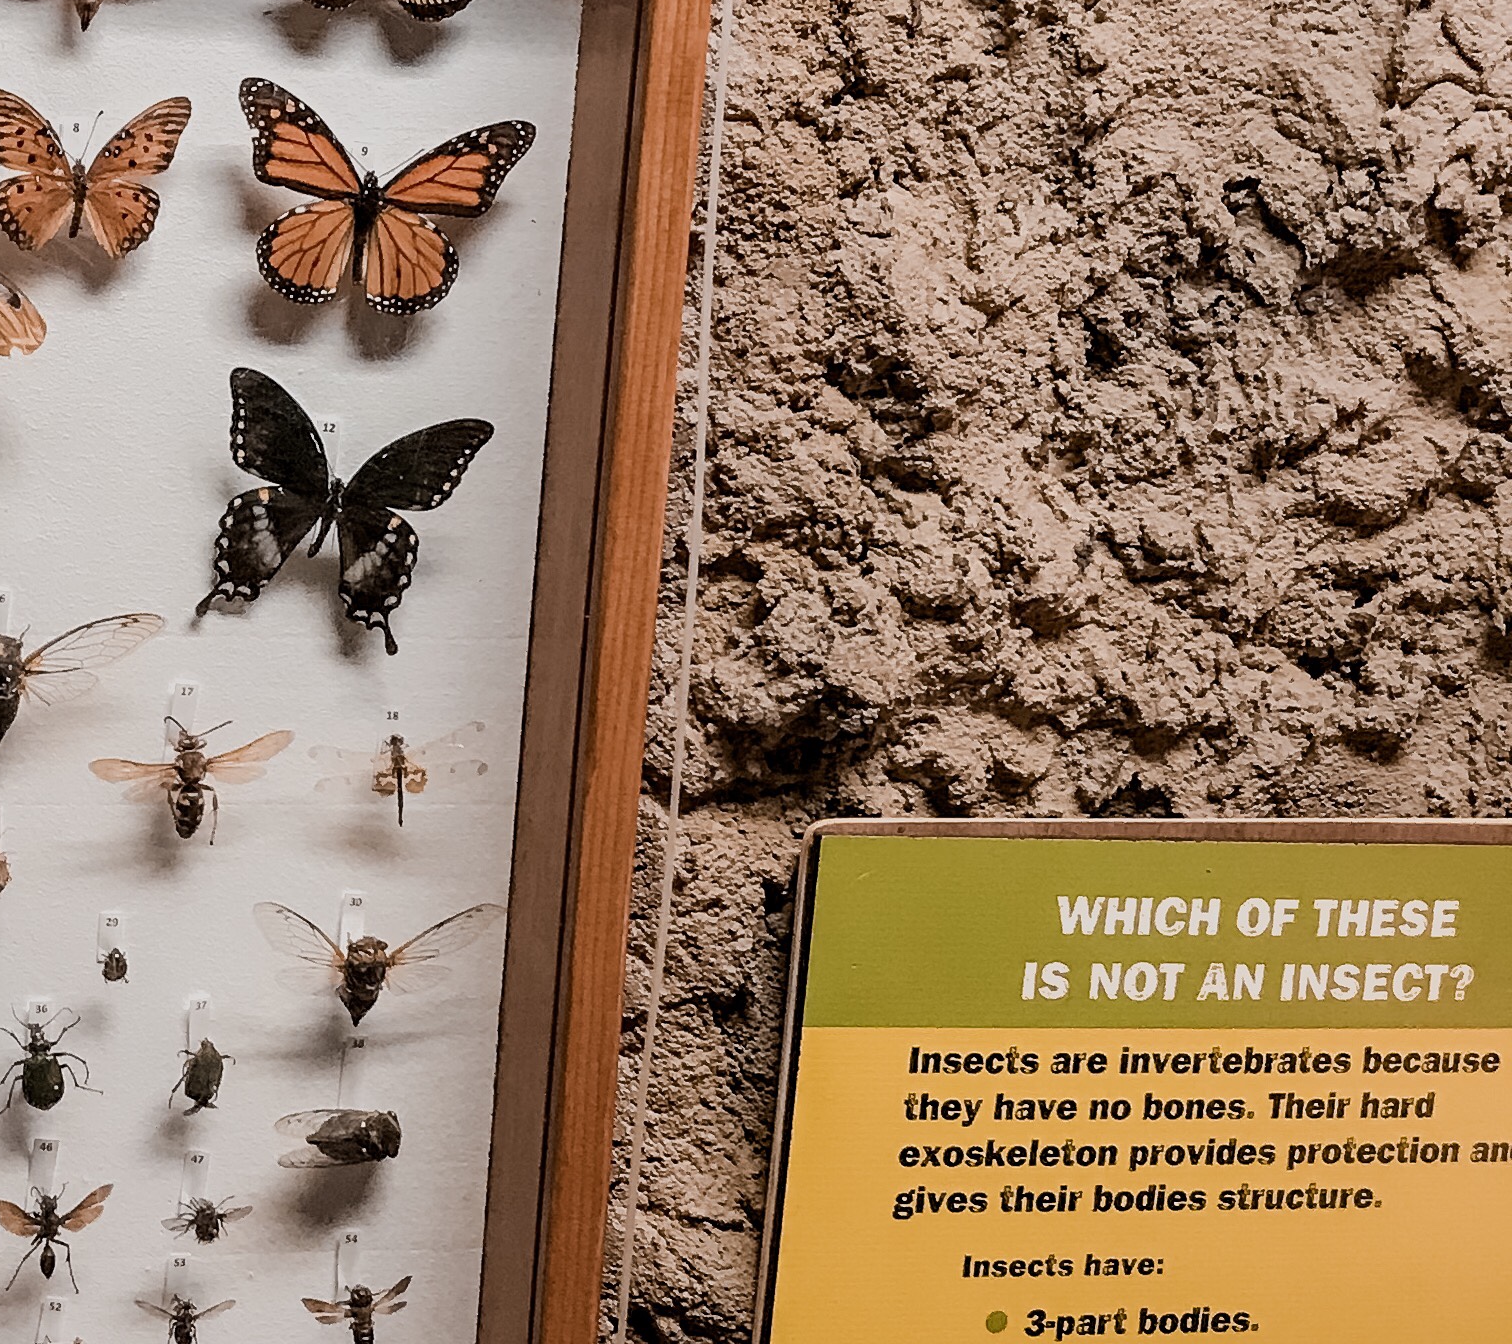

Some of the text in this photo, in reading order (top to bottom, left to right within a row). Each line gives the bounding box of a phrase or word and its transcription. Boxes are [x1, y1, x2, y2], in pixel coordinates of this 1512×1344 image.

[72, 122, 80, 133] 8
[361, 146, 369, 156] 9
[322, 423, 336, 433] 12
[181, 687, 194, 696] 17
[386, 711, 399, 721] 18
[105, 917, 119, 927] 29
[1058, 896, 1459, 937] WHICH OF THESE
[1022, 962, 1474, 1001] IS NOT AN INSECT?
[196, 1000, 207, 1011] 37
[909, 1046, 1500, 1074] Insects are invertebrates because
[904, 1092, 1435, 1127] they have no bones. Their hard
[899, 1137, 1512, 1172] exoskeleton provides protection an
[892, 1183, 1382, 1220] gives their bodies structure.
[173, 1258, 186, 1268] 53
[962, 1254, 1163, 1278] Insects have:
[1024, 1306, 1259, 1342] 3-part bodies.
